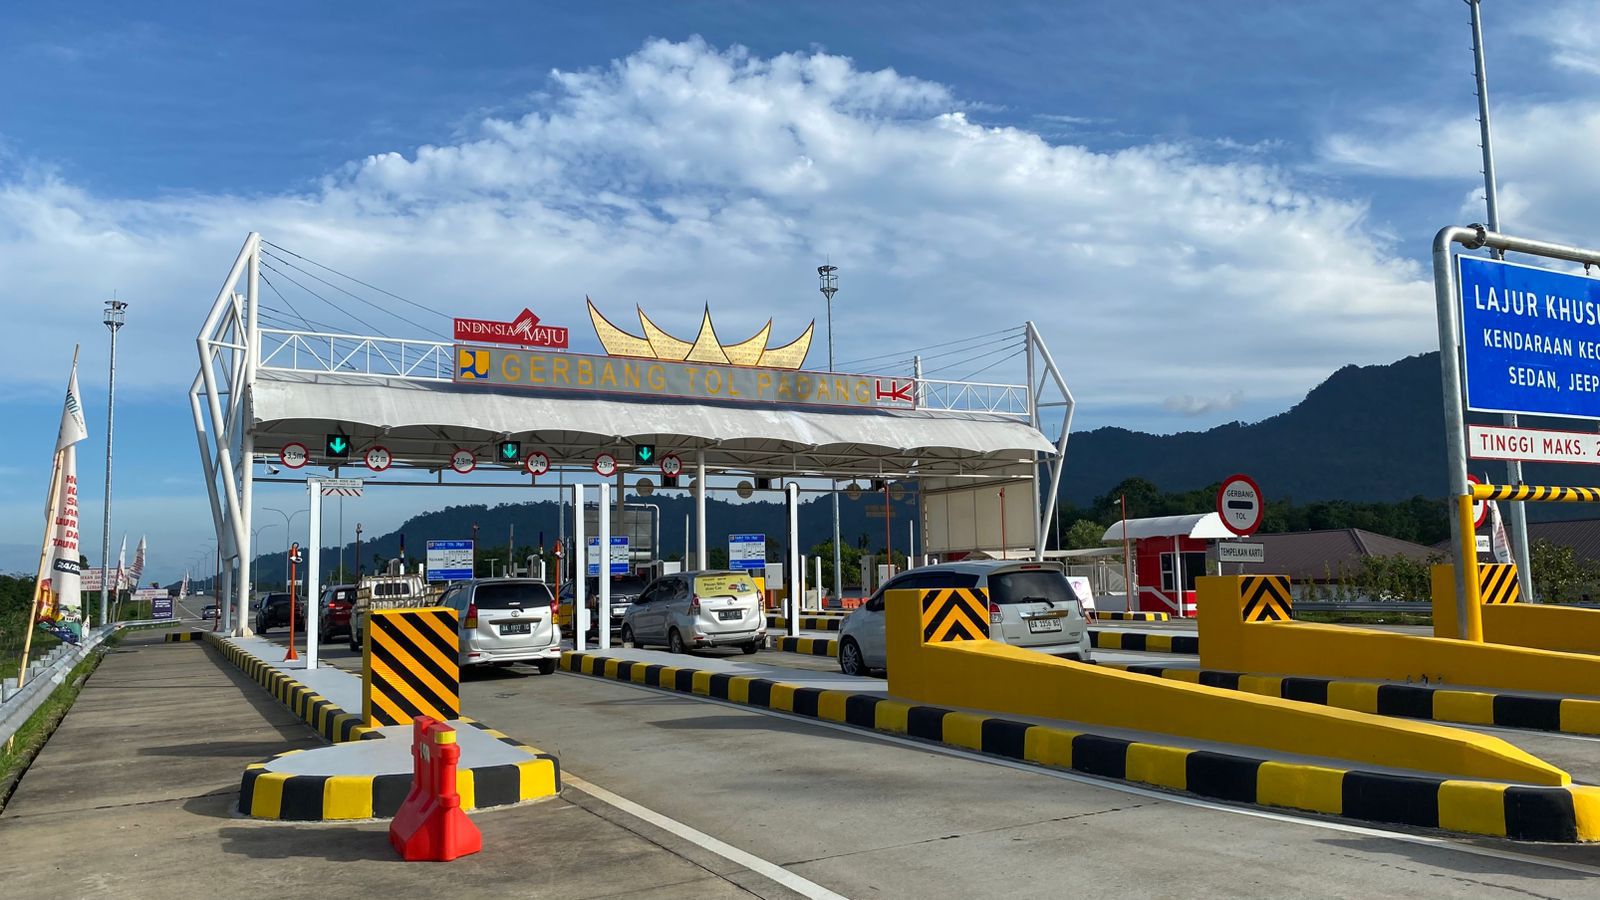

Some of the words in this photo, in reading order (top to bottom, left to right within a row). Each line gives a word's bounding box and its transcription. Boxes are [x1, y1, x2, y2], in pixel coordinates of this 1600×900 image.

[1475, 284, 1538, 317] LAJUR
[524, 325, 565, 345] MAJU
[1484, 328, 1572, 356] KENDARAAN
[501, 353, 665, 391] GERBANG
[685, 367, 739, 396] TOL
[757, 373, 871, 403] PADANG
[1508, 366, 1560, 392] SEDAN,
[1569, 373, 1600, 393] JEEP
[1480, 433, 1534, 454] TINGGI
[1543, 438, 1586, 456] MAKS.
[1227, 489, 1254, 498] GERBANG
[1235, 512, 1246, 520] TOL
[1221, 547, 1248, 557] TEMPELKAN
[1249, 548, 1262, 558] KARTU
